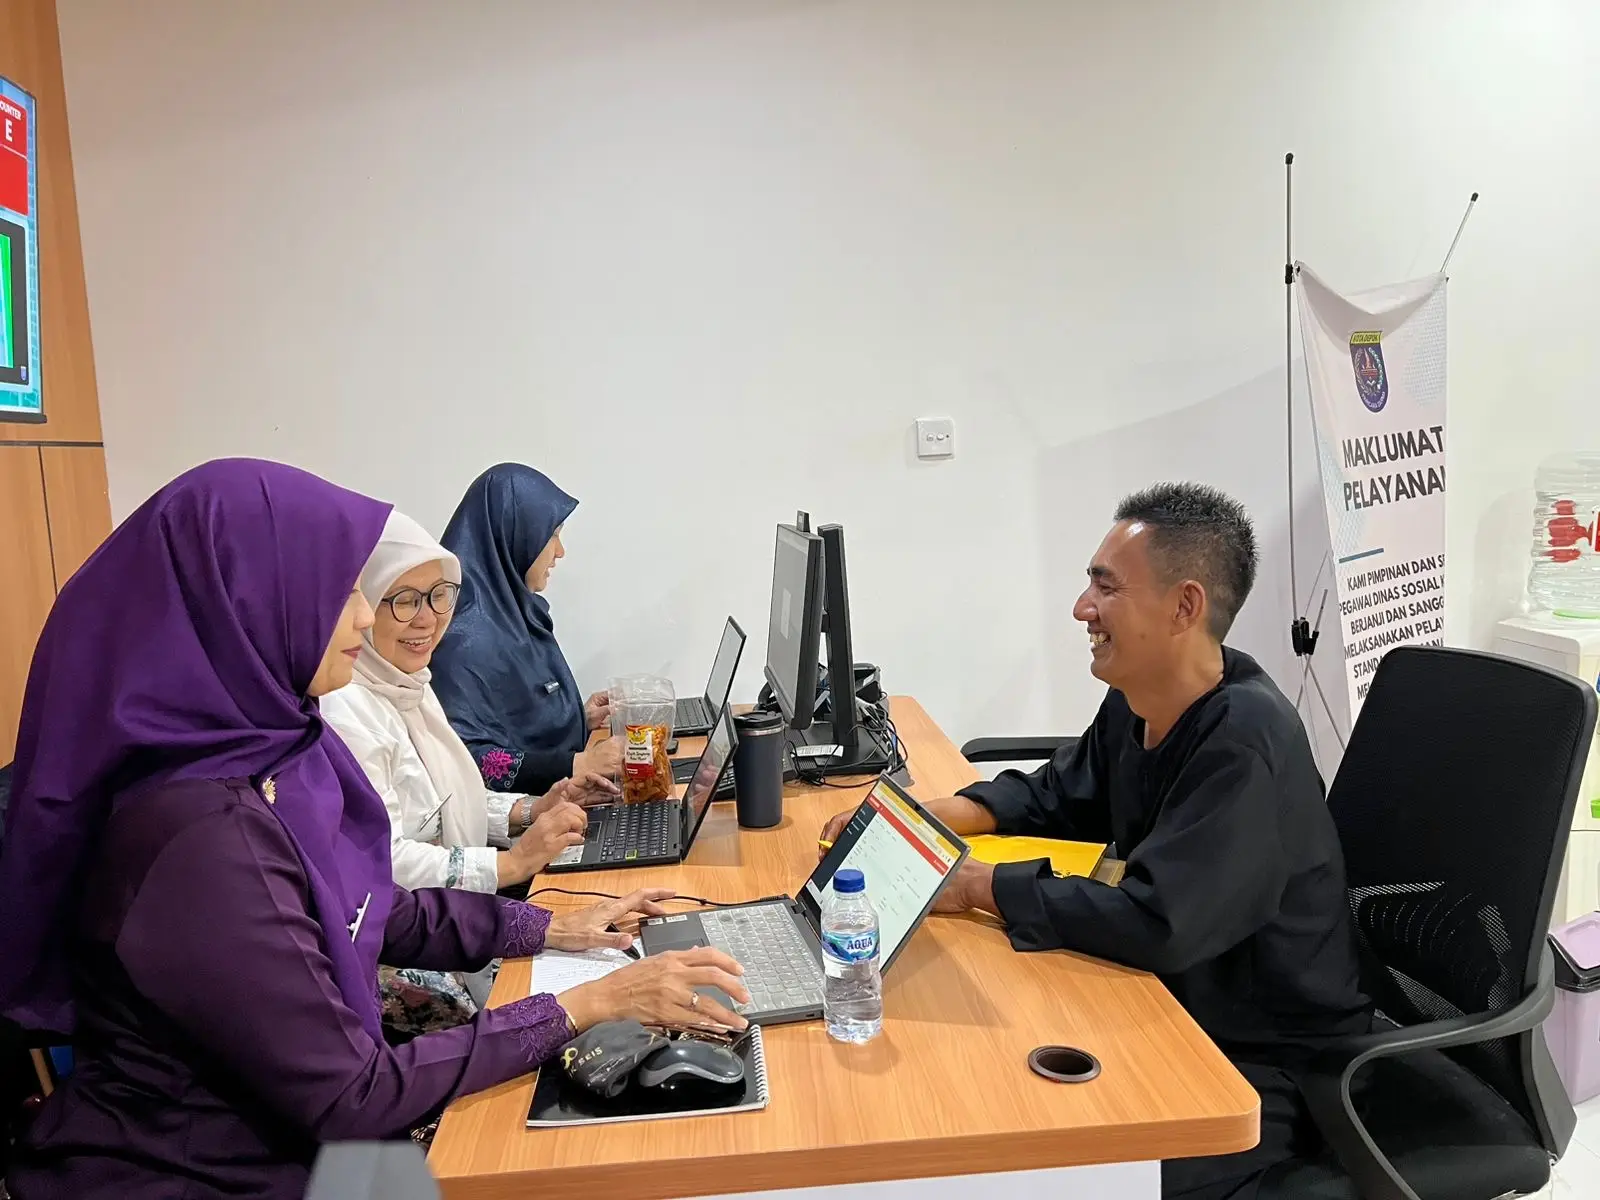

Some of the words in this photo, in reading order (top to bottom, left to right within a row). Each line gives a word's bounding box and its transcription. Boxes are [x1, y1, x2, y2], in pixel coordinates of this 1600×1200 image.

[5, 118, 13, 142] E
[1342, 425, 1444, 469] MAKLUMAT
[1347, 574, 1367, 592] KAMI
[1367, 562, 1411, 586] PIMPINAN
[1411, 556, 1437, 574] DAN
[1373, 586, 1400, 606] DINAS
[1402, 577, 1440, 597] SOSIAL
[1350, 611, 1385, 635] BERJANJI
[1386, 606, 1408, 624] DAN
[1344, 625, 1416, 660] MELAKSANAKAN
[1353, 656, 1383, 678] STAND
[846, 937, 873, 950] AQUA
